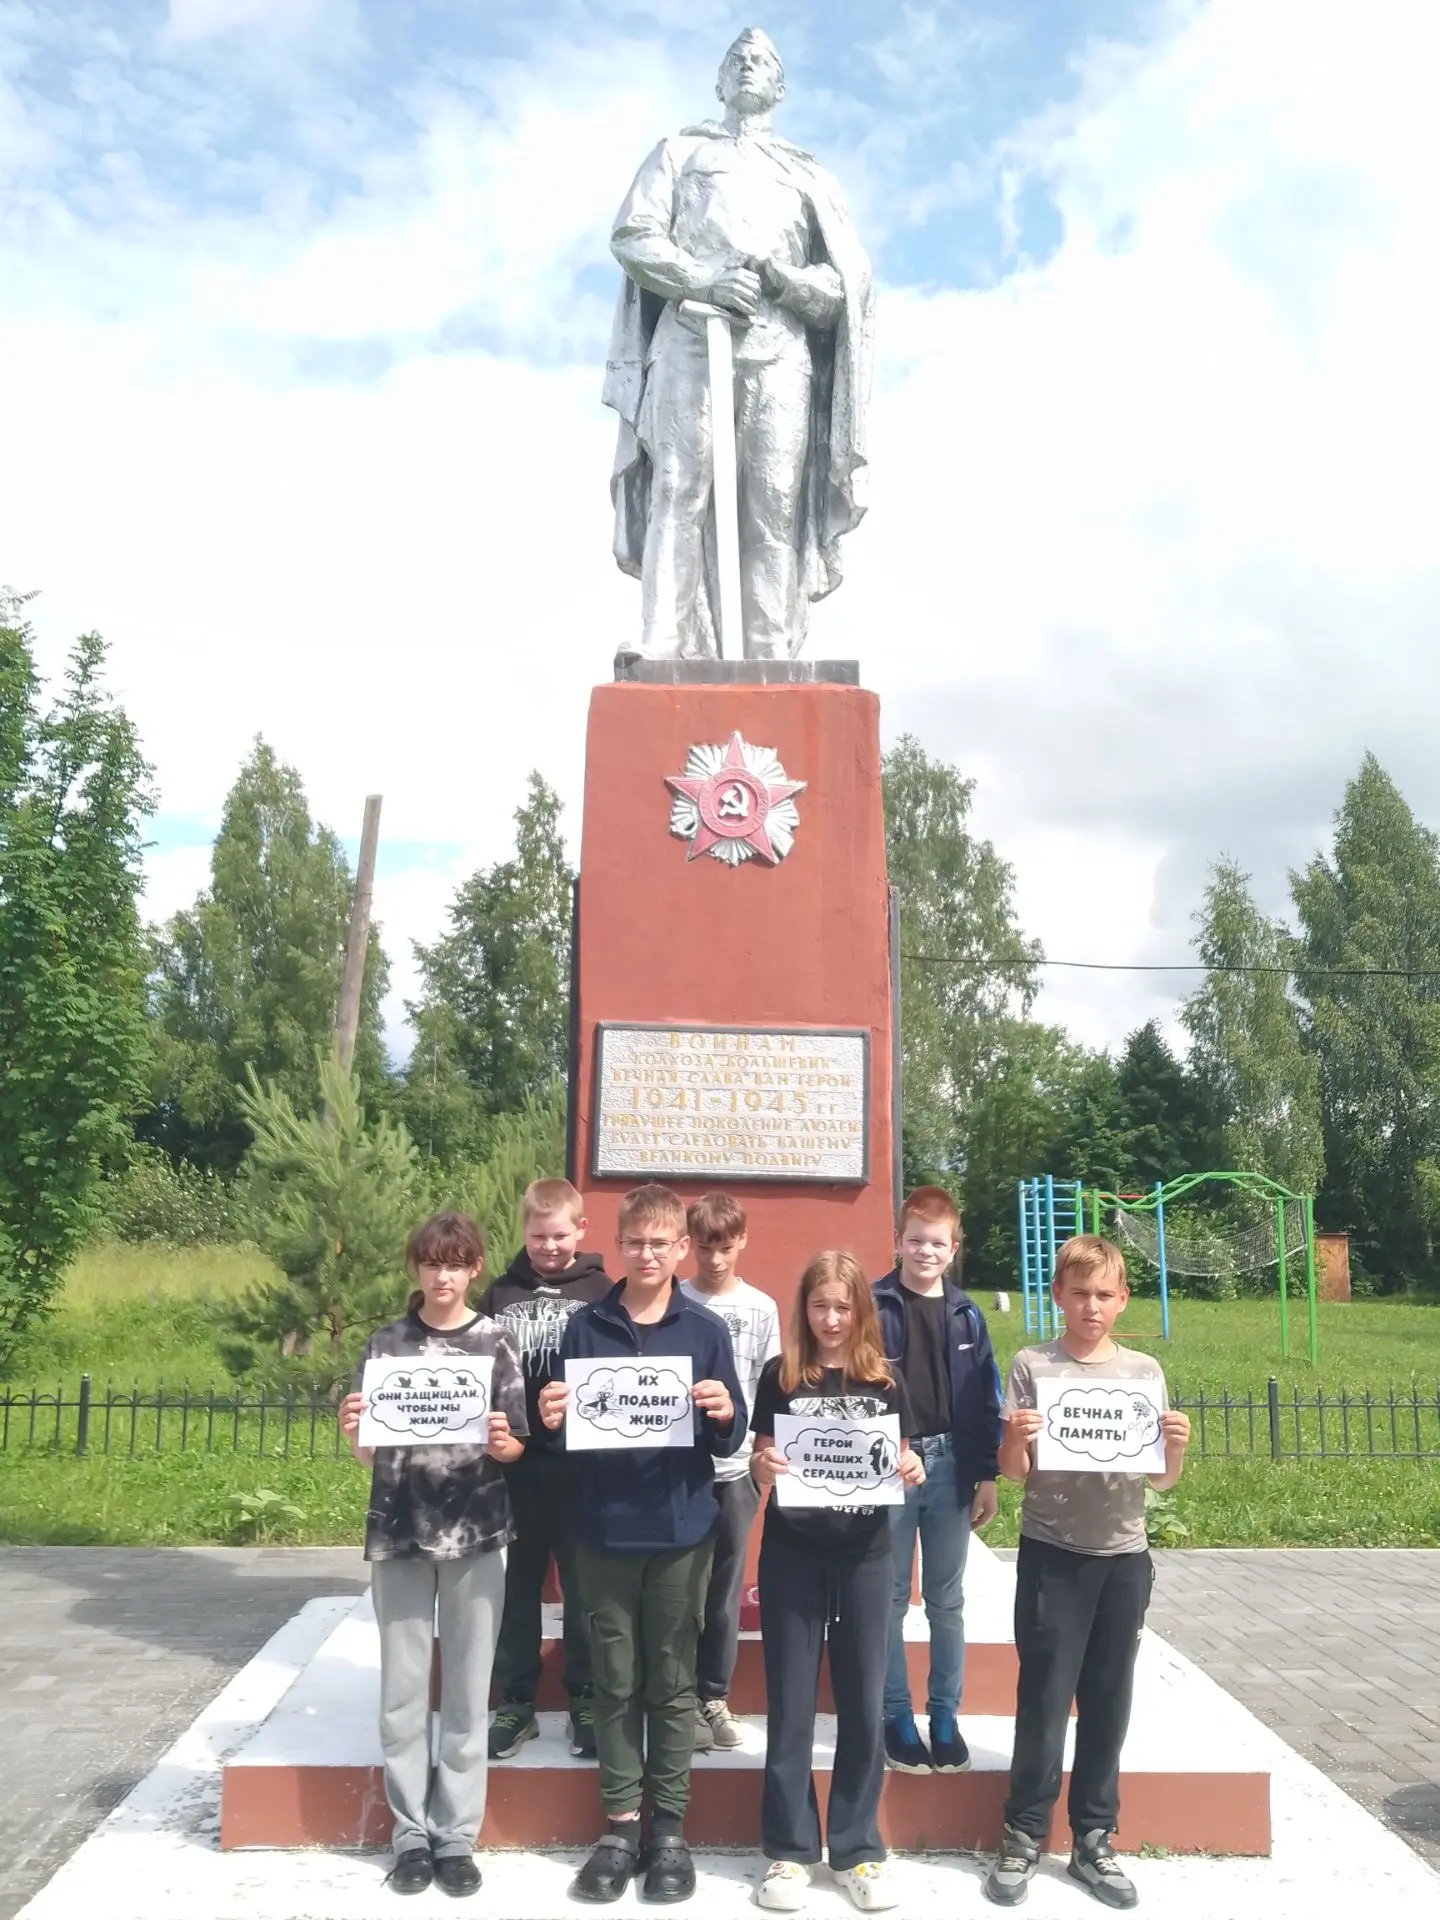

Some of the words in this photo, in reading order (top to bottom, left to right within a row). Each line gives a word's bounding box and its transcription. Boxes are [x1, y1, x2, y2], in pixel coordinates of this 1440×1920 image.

[669, 1031, 798, 1051] ВОИНАМ
[613, 1069, 679, 1082] ВЕЧНАЯ
[689, 1071, 744, 1085] СЛАВА
[632, 1087, 809, 1114] 1941-1945
[692, 1115, 793, 1131] ПОКОЛЕНИЕ
[640, 1149, 733, 1164] ВЕЛИКОМУ
[638, 1375, 659, 1386] ИХ
[377, 1391, 402, 1401] ОНИ
[618, 1394, 680, 1408] ПОДВИГ
[397, 1404, 438, 1413] ЧТОБЫ
[440, 1403, 461, 1412] МЫ
[1063, 1406, 1123, 1420] ВЕЧНАЯ
[409, 1416, 449, 1426] ЖИЛИ!
[628, 1414, 669, 1426] ЖИВ!
[1059, 1427, 1126, 1442] ПАМЯТЬ!
[813, 1437, 853, 1449] ГЕРОИ
[803, 1453, 812, 1462] В
[814, 1453, 864, 1465] НАШИХ
[802, 1468, 868, 1480] СЕРДЦАХ!
